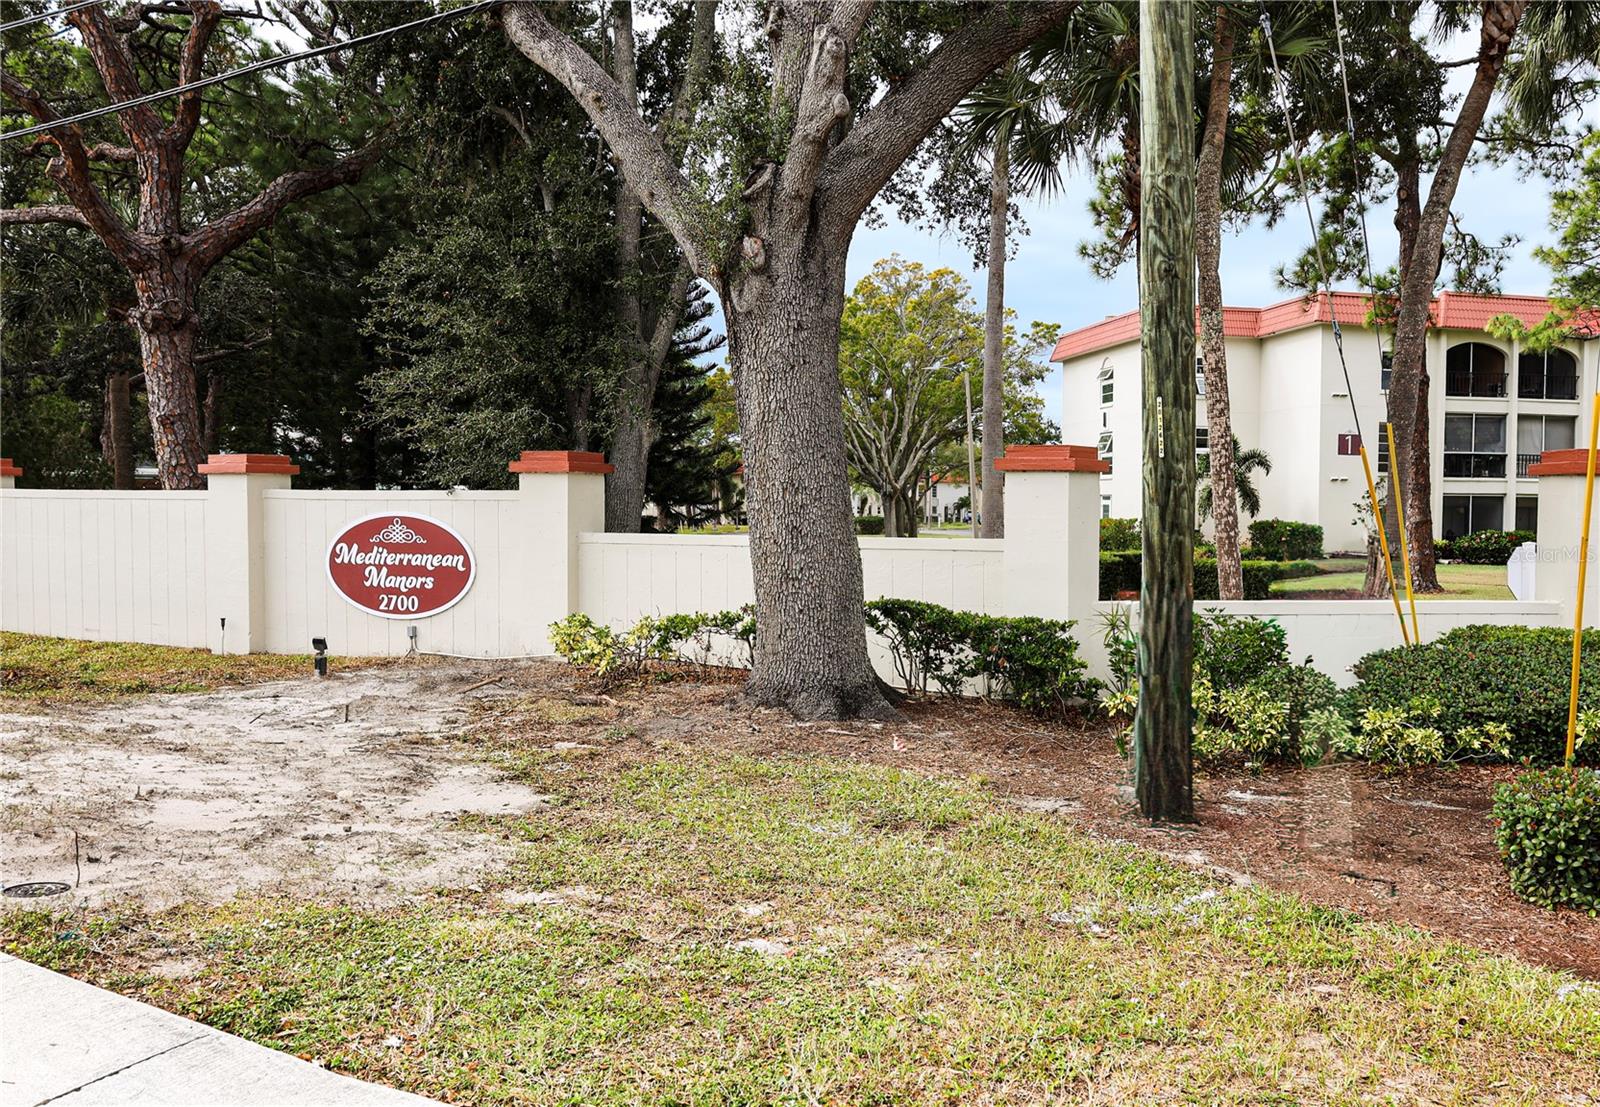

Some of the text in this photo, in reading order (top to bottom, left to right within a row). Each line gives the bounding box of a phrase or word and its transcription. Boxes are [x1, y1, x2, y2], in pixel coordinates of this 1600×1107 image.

[1345, 435, 1352, 455] 1
[335, 542, 466, 571] Mediterranean
[363, 566, 435, 592] Manors
[378, 594, 419, 612] 2700
